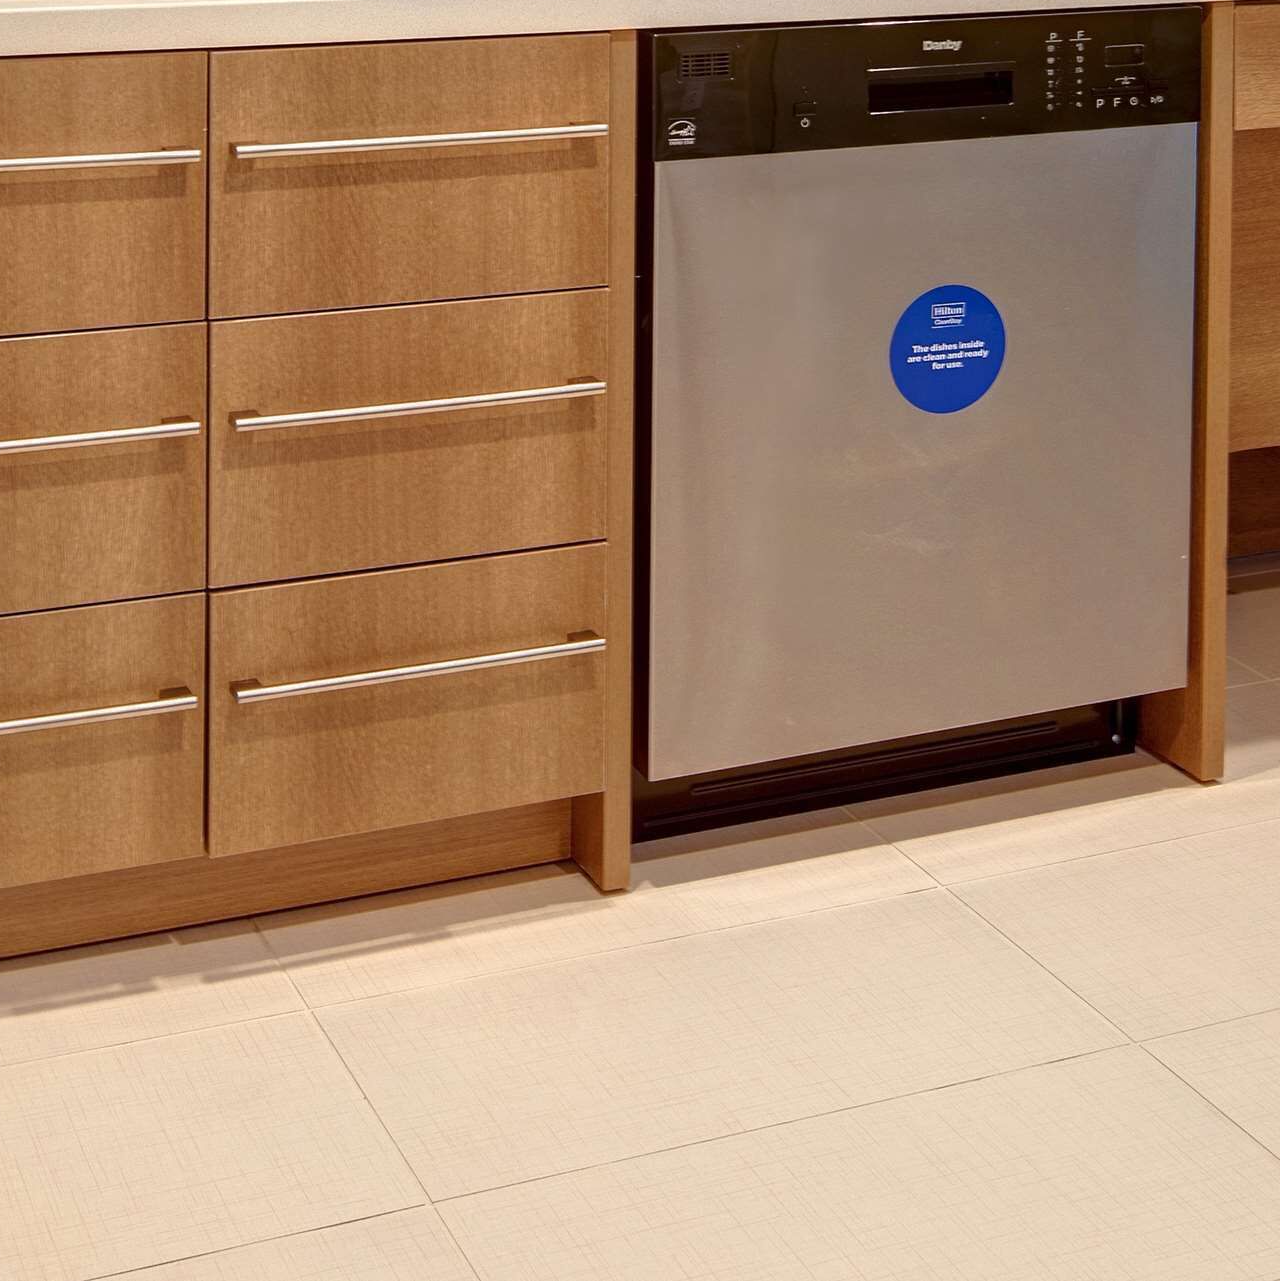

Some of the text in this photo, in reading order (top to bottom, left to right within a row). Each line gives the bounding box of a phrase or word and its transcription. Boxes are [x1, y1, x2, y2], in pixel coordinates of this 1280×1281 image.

[922, 39, 963, 51] Danby
[933, 306, 963, 317] Hilton
[911, 340, 985, 353] The dishes inside
[906, 349, 990, 364] are clean and ready
[931, 361, 946, 370] for
